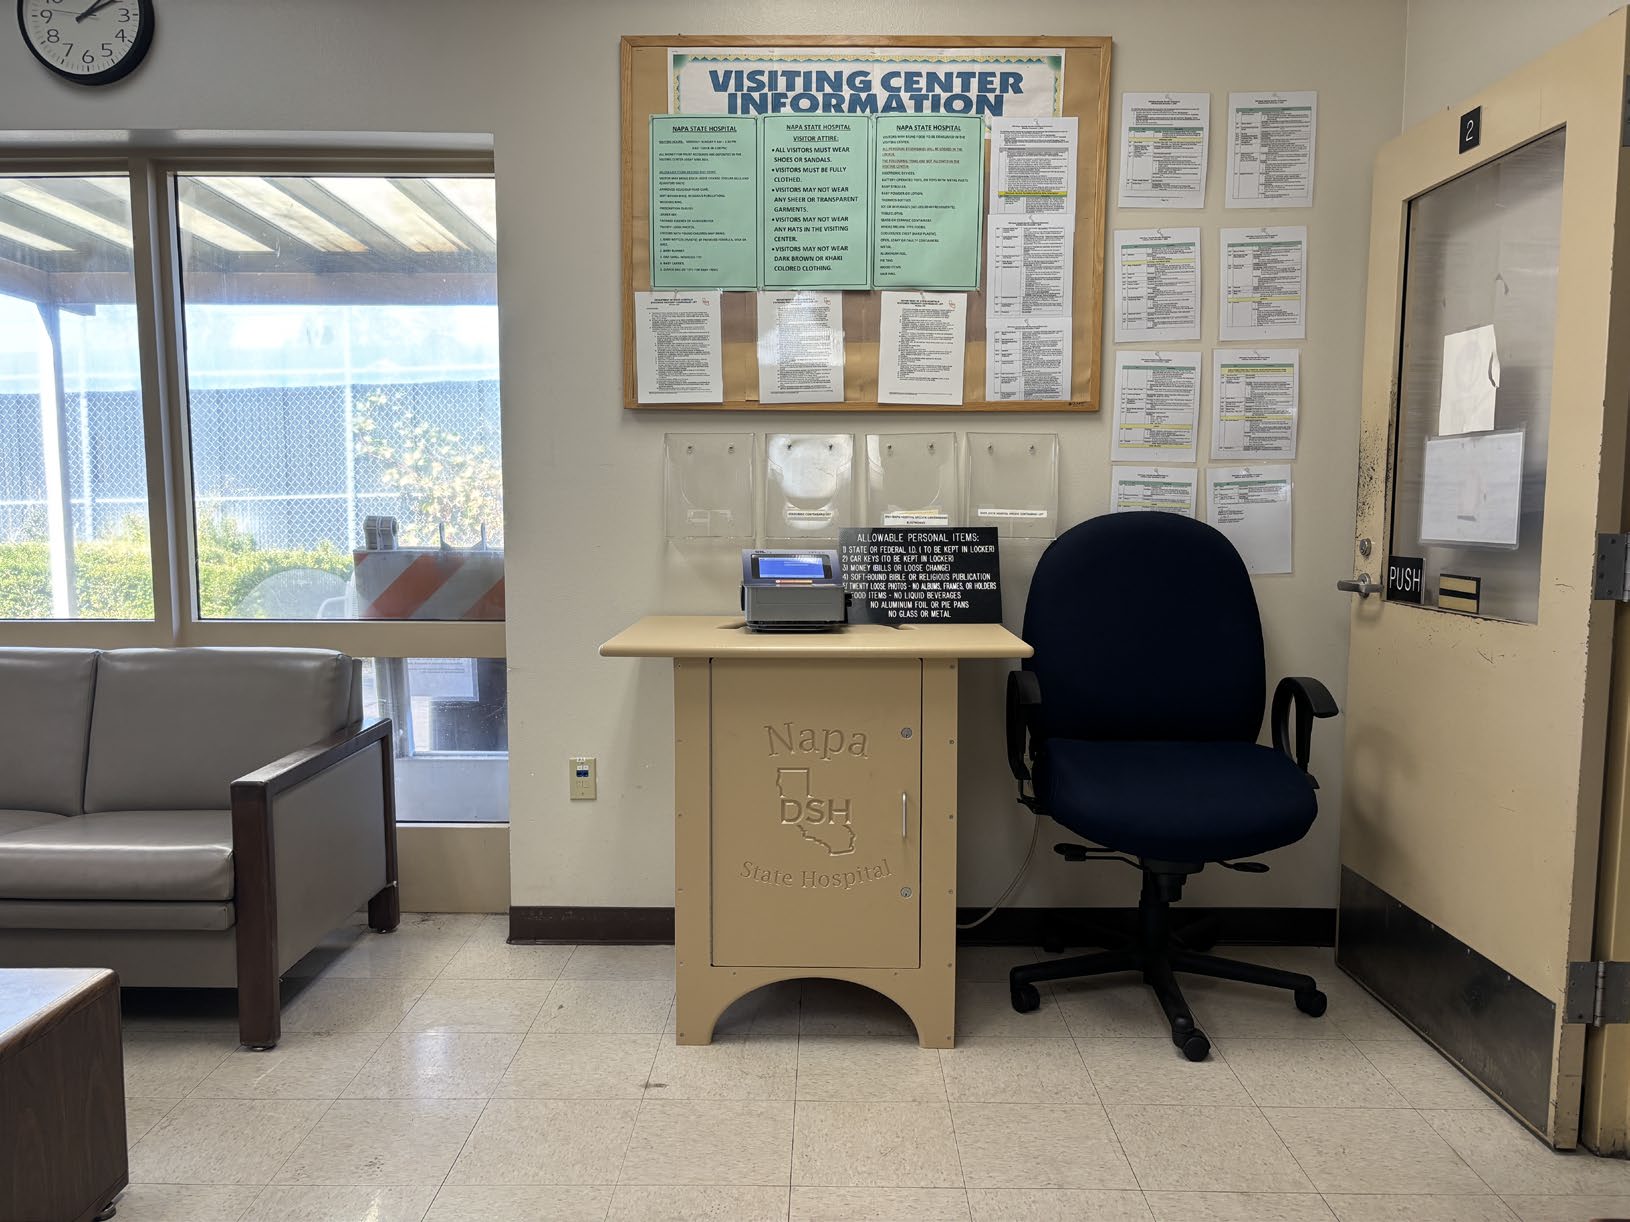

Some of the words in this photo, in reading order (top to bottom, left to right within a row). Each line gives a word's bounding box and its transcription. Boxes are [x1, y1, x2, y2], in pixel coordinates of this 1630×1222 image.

[40, 10, 53, 24] 9
[118, 8, 130, 22] 3
[47, 29, 60, 43] 8
[114, 29, 127, 42] 4
[62, 43, 73, 57] 7
[82, 50, 94, 63] 6
[101, 43, 113, 57] 5
[708, 70, 873, 93] VISITING
[880, 71, 1024, 94] CENTER
[727, 92, 1005, 116] INFORMATION
[1465, 119, 1474, 142] 2
[857, 533, 904, 542] ALLOWABLE
[908, 533, 949, 542] PERSONAL
[953, 533, 979, 542] ITEMS:
[970, 545, 995, 553] LOCKER)
[850, 582, 869, 590] TWENTY
[870, 582, 886, 590] LOOSE
[888, 582, 907, 590] PHOTOS
[912, 582, 919, 590] NO
[966, 582, 973, 590] OR
[1389, 566, 1421, 592] PUSH
[888, 610, 897, 618] NO
[899, 610, 918, 618] GLASS
[920, 610, 928, 618] OR
[931, 610, 951, 618] METAL
[764, 722, 869, 761] Napa
[781, 799, 851, 825] DSH
[740, 860, 793, 886] State
[801, 858, 893, 890] Hospital
